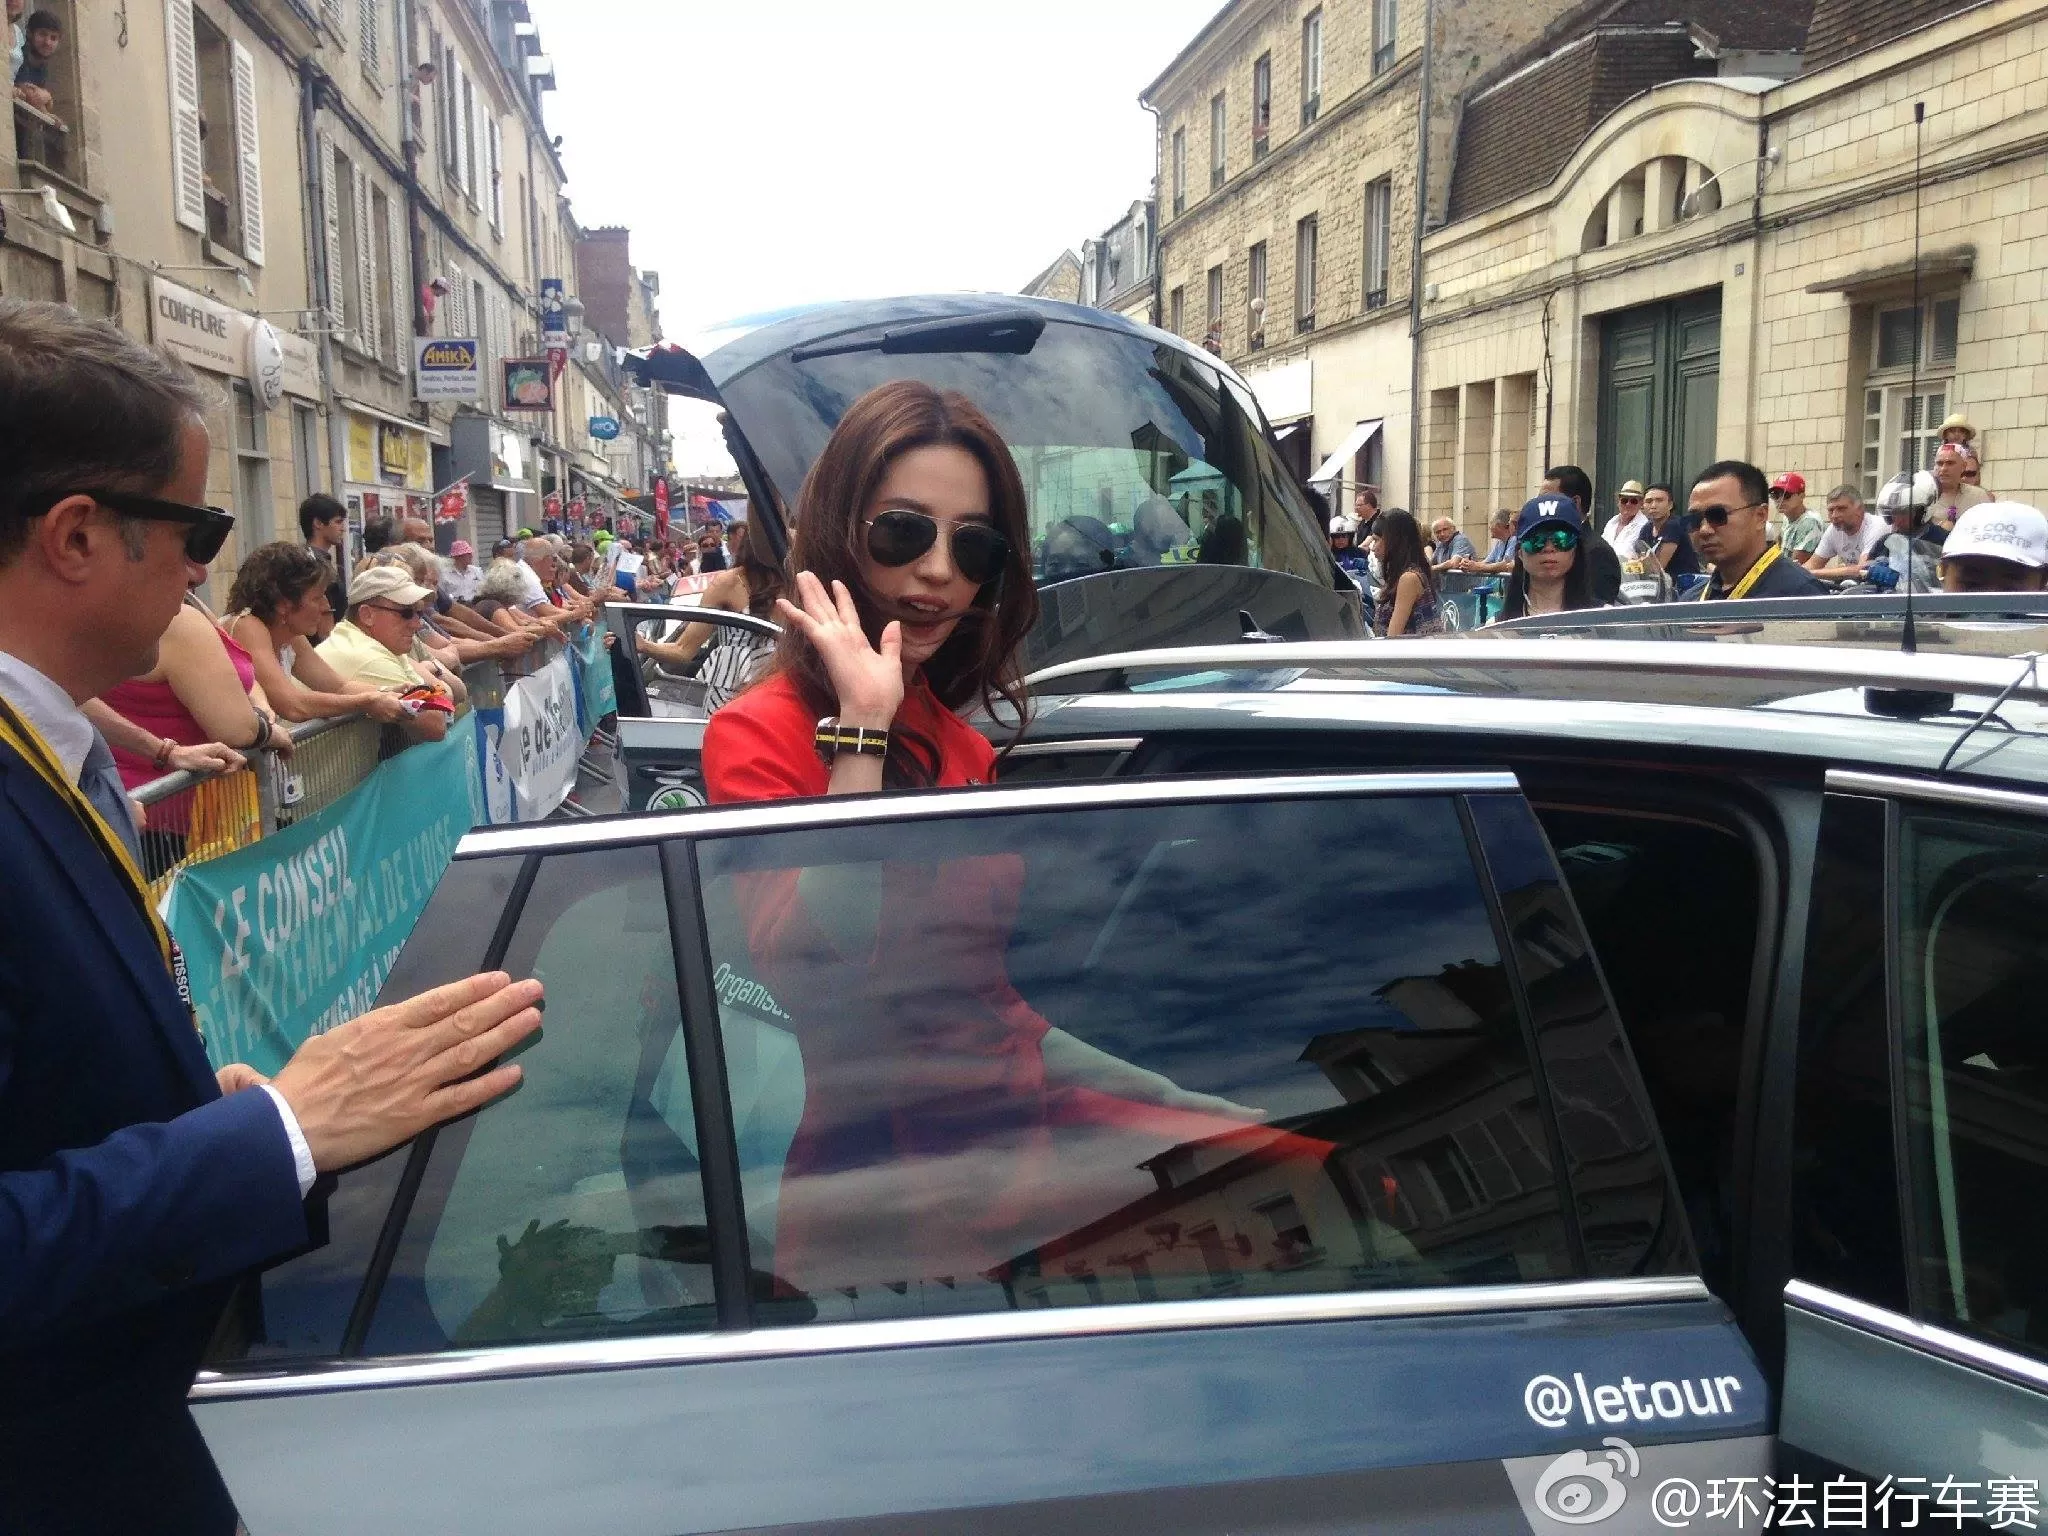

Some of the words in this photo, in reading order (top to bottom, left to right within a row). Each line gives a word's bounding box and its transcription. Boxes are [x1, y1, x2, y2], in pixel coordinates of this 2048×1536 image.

[158, 296, 227, 339] COIFFURE
[1538, 500, 1558, 516] W
[258, 825, 358, 953] CONSEIL
[380, 849, 409, 925] DE
[173, 952, 190, 1005] TISSOT
[1524, 1372, 1742, 1428] @letour
